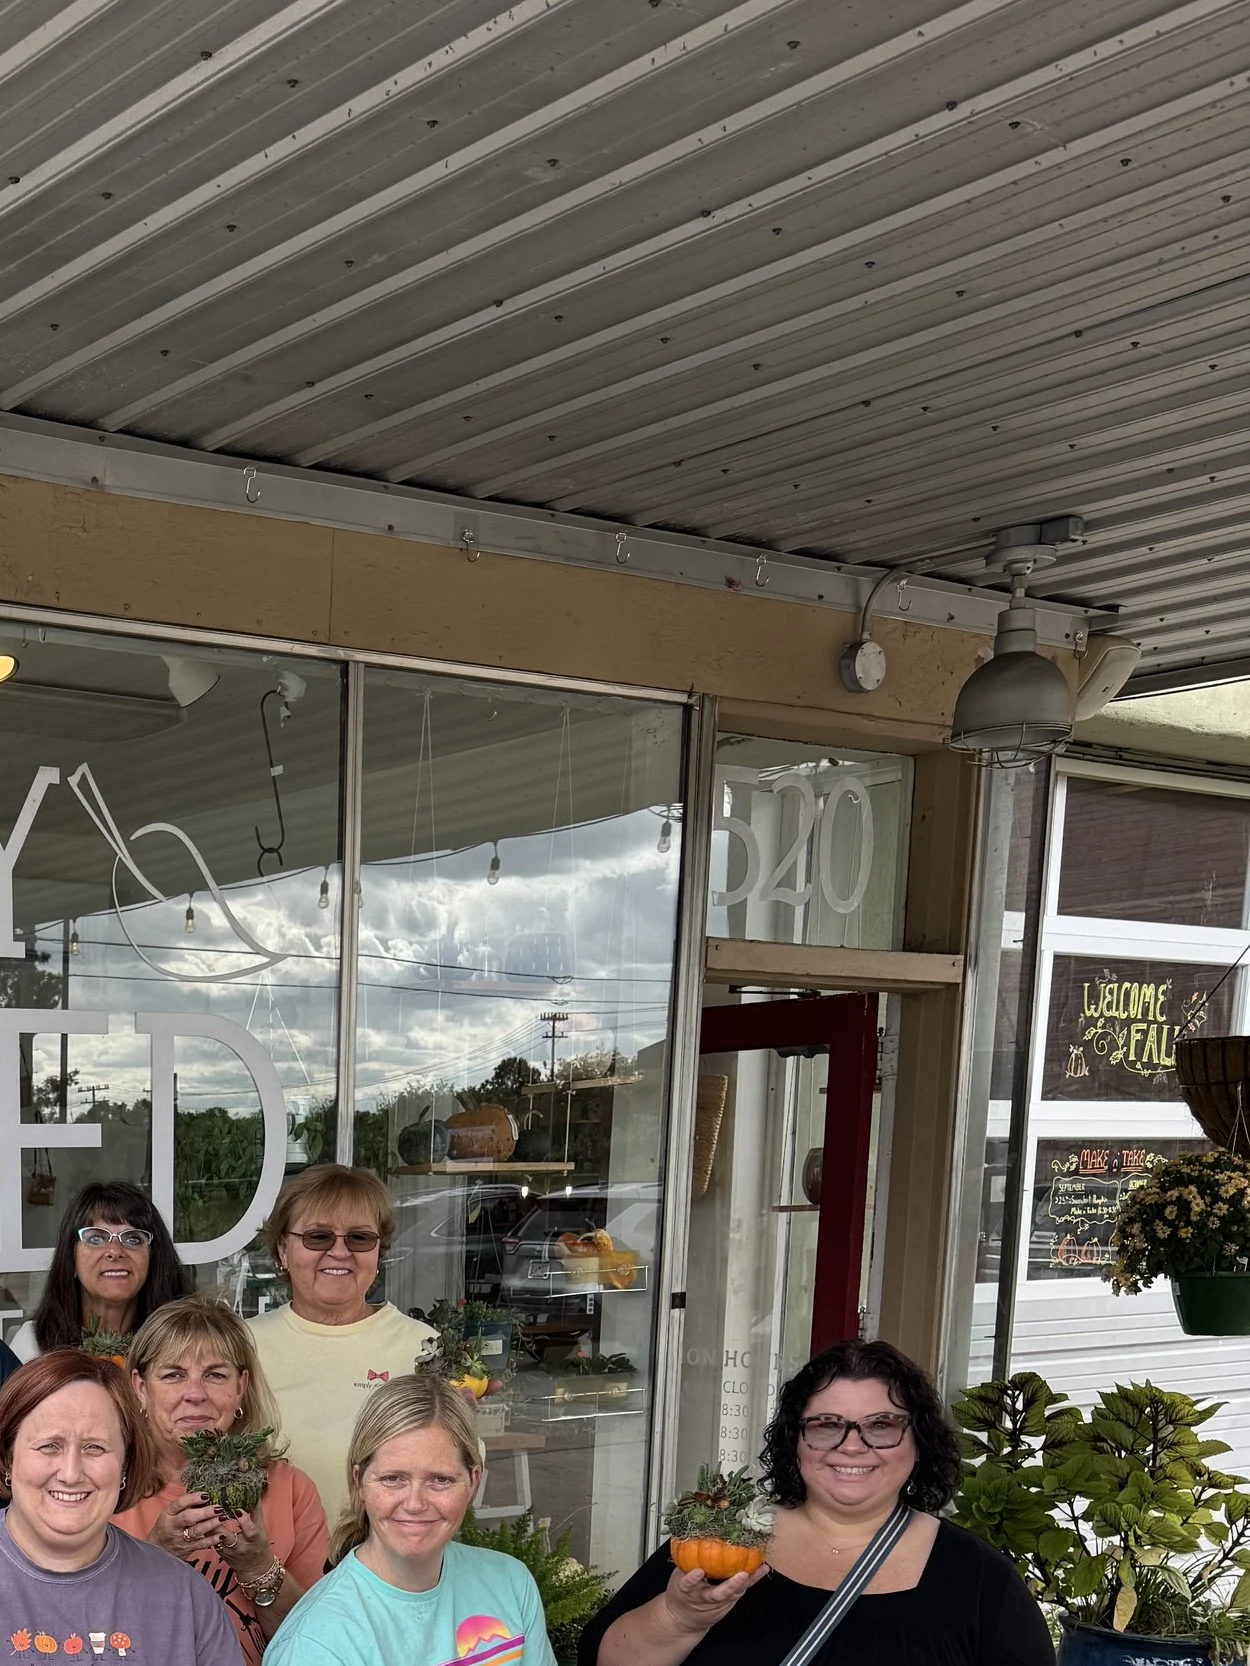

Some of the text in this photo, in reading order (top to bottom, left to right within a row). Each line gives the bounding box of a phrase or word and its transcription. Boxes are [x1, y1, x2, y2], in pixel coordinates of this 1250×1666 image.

[712, 764, 875, 914] 520
[1083, 981, 1167, 1021] WELCOME
[1079, 1149, 1109, 1169] MAKE
[1122, 1149, 1146, 1166] TAKE
[722, 1381, 776, 1397] CLOD
